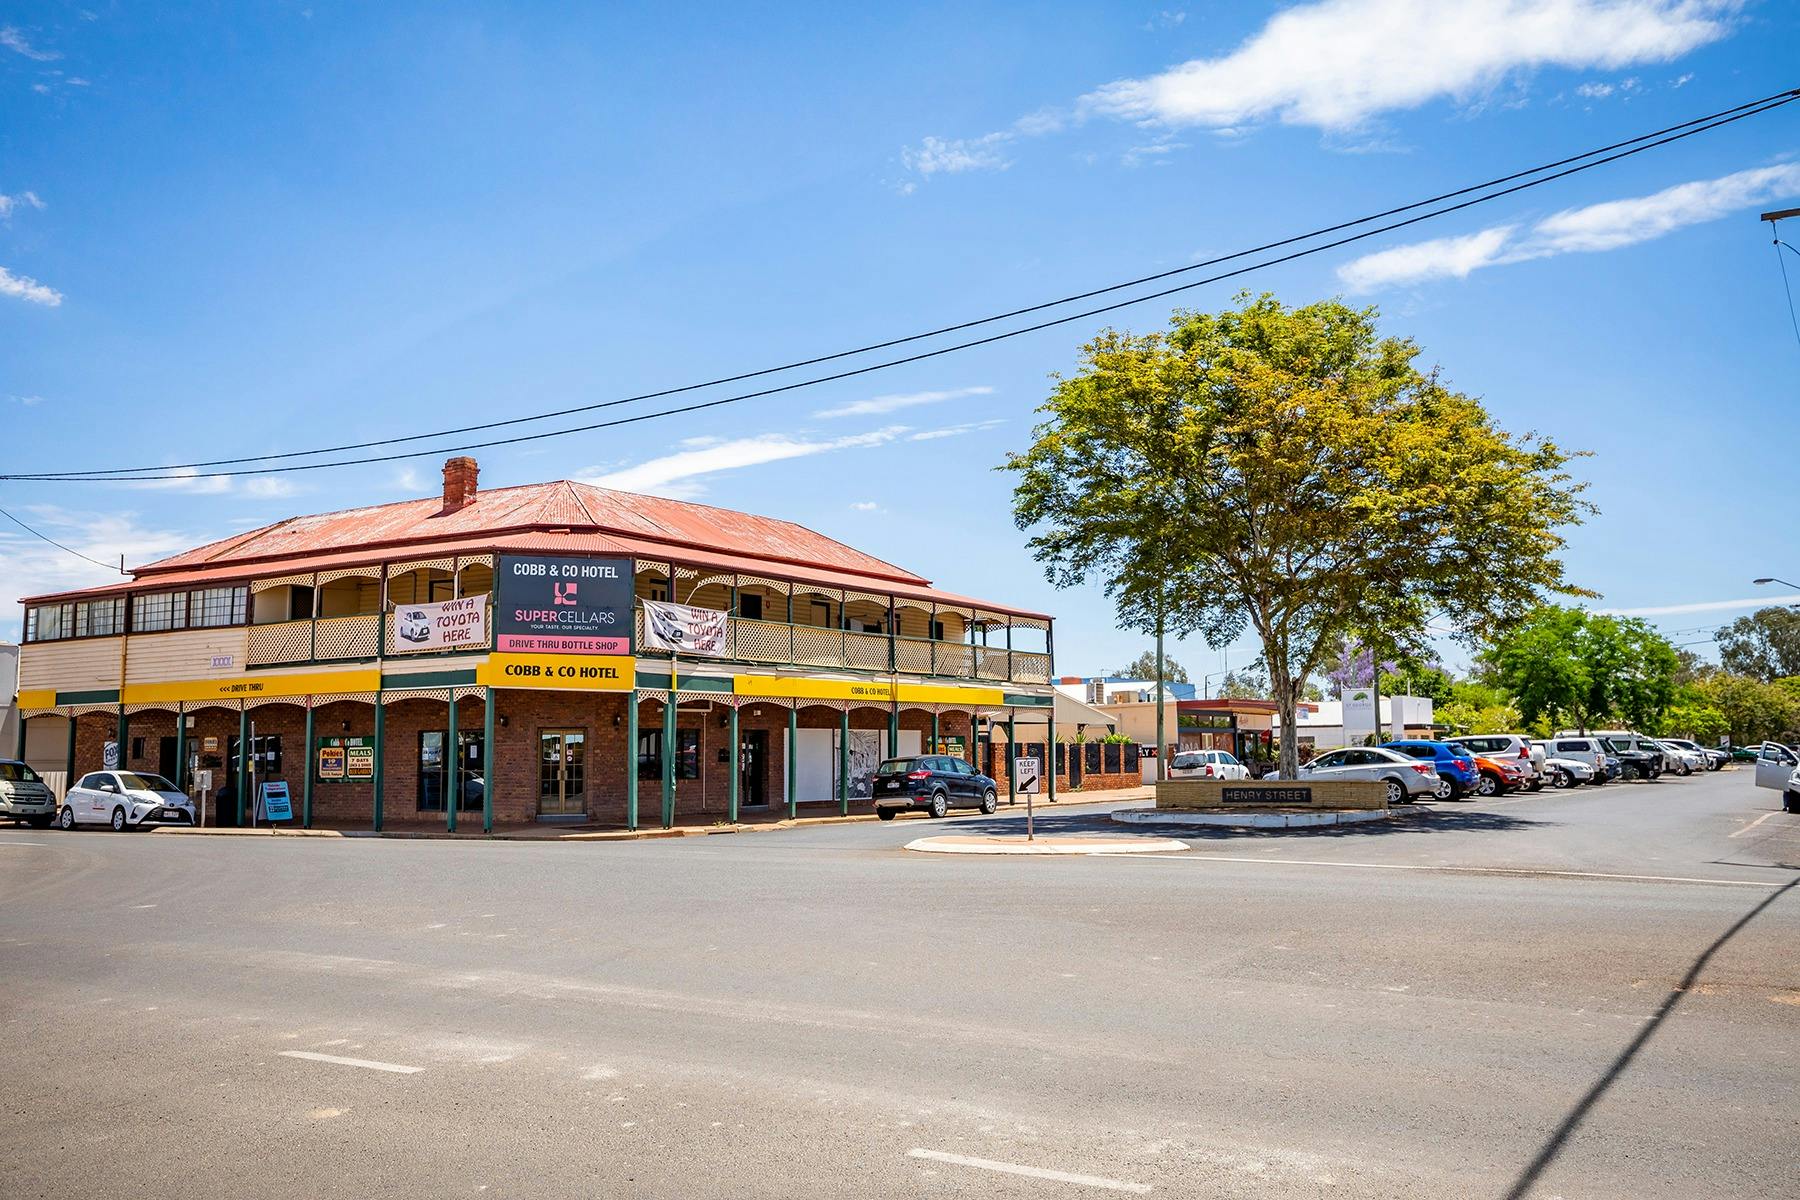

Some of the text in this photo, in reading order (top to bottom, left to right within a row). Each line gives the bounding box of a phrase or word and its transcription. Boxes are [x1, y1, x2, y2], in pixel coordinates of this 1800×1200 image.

[513, 563, 619, 578] COBB & CO HOTEL
[441, 598, 475, 613] WIN A
[437, 611, 480, 628] TOYOTA
[515, 610, 615, 624] SUPERCELLARS
[690, 608, 718, 622] WIN A
[442, 628, 471, 642] HERE
[687, 622, 723, 638] TOYOTA
[509, 639, 618, 651] DRIVE THRU BOTTLE SHOP
[693, 638, 716, 652] HERE
[505, 664, 619, 678] COBB & CO HOTEL
[231, 684, 247, 692] DRIVE
[248, 682, 264, 691] THRU
[851, 686, 864, 694] COBB
[869, 688, 876, 696] CO
[877, 688, 891, 696] HOTEL
[1226, 790, 1307, 800] HENRY STREET
